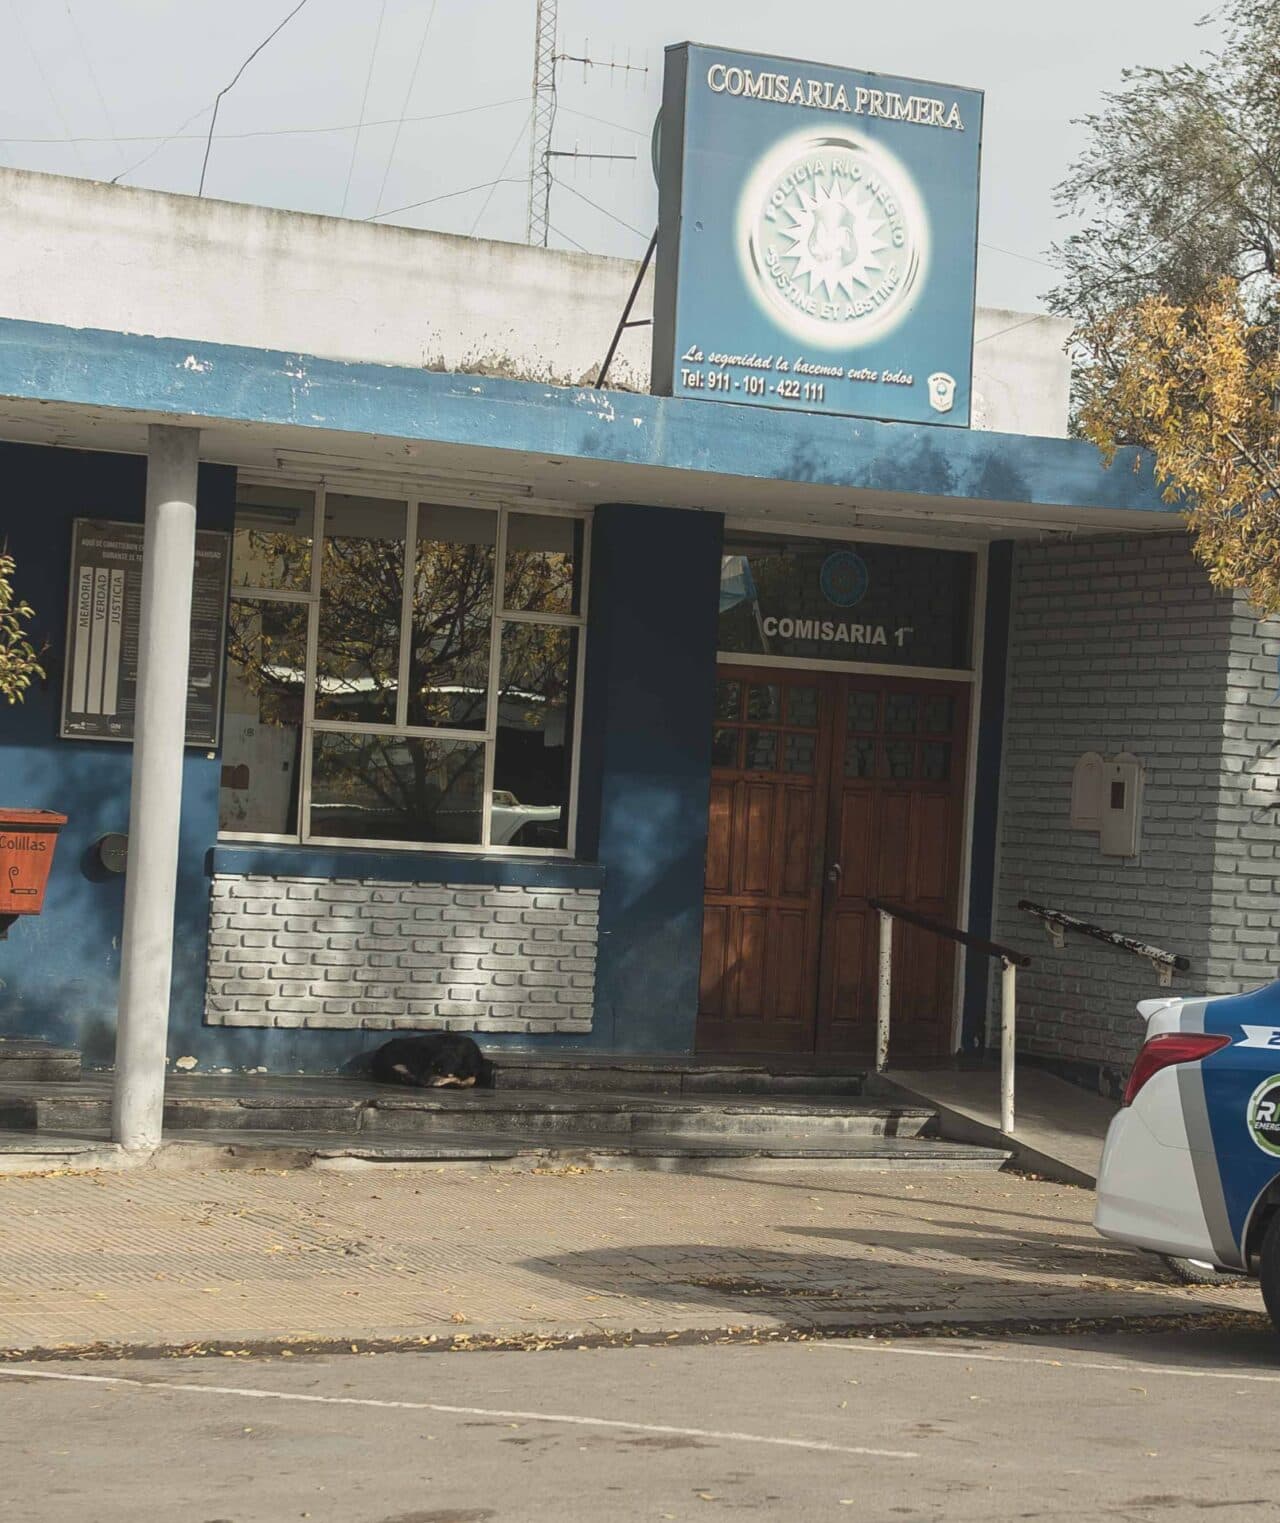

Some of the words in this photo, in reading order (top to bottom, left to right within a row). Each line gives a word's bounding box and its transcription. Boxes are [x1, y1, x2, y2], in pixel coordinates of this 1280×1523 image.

[707, 63, 851, 113] COMISARIA
[854, 86, 964, 130] PRIMERA
[765, 159, 825, 223] POLICIA
[831, 159, 863, 182] RIO
[680, 368, 704, 387] Tel:
[707, 371, 730, 390] 911
[743, 375, 766, 394] 101
[776, 379, 800, 397] 422
[803, 381, 824, 400] 111
[681, 345, 704, 361] La
[707, 352, 773, 369] seguridad
[775, 356, 790, 370] la
[793, 357, 843, 376] hacemos
[847, 367, 878, 381] entre
[881, 369, 913, 385] todos
[79, 573, 91, 628] MEMORIA
[95, 574, 107, 621] VERDAD
[111, 576, 123, 624] JUSTICIA
[763, 616, 888, 646] COMISARIA
[0, 835, 46, 851] Colillas
